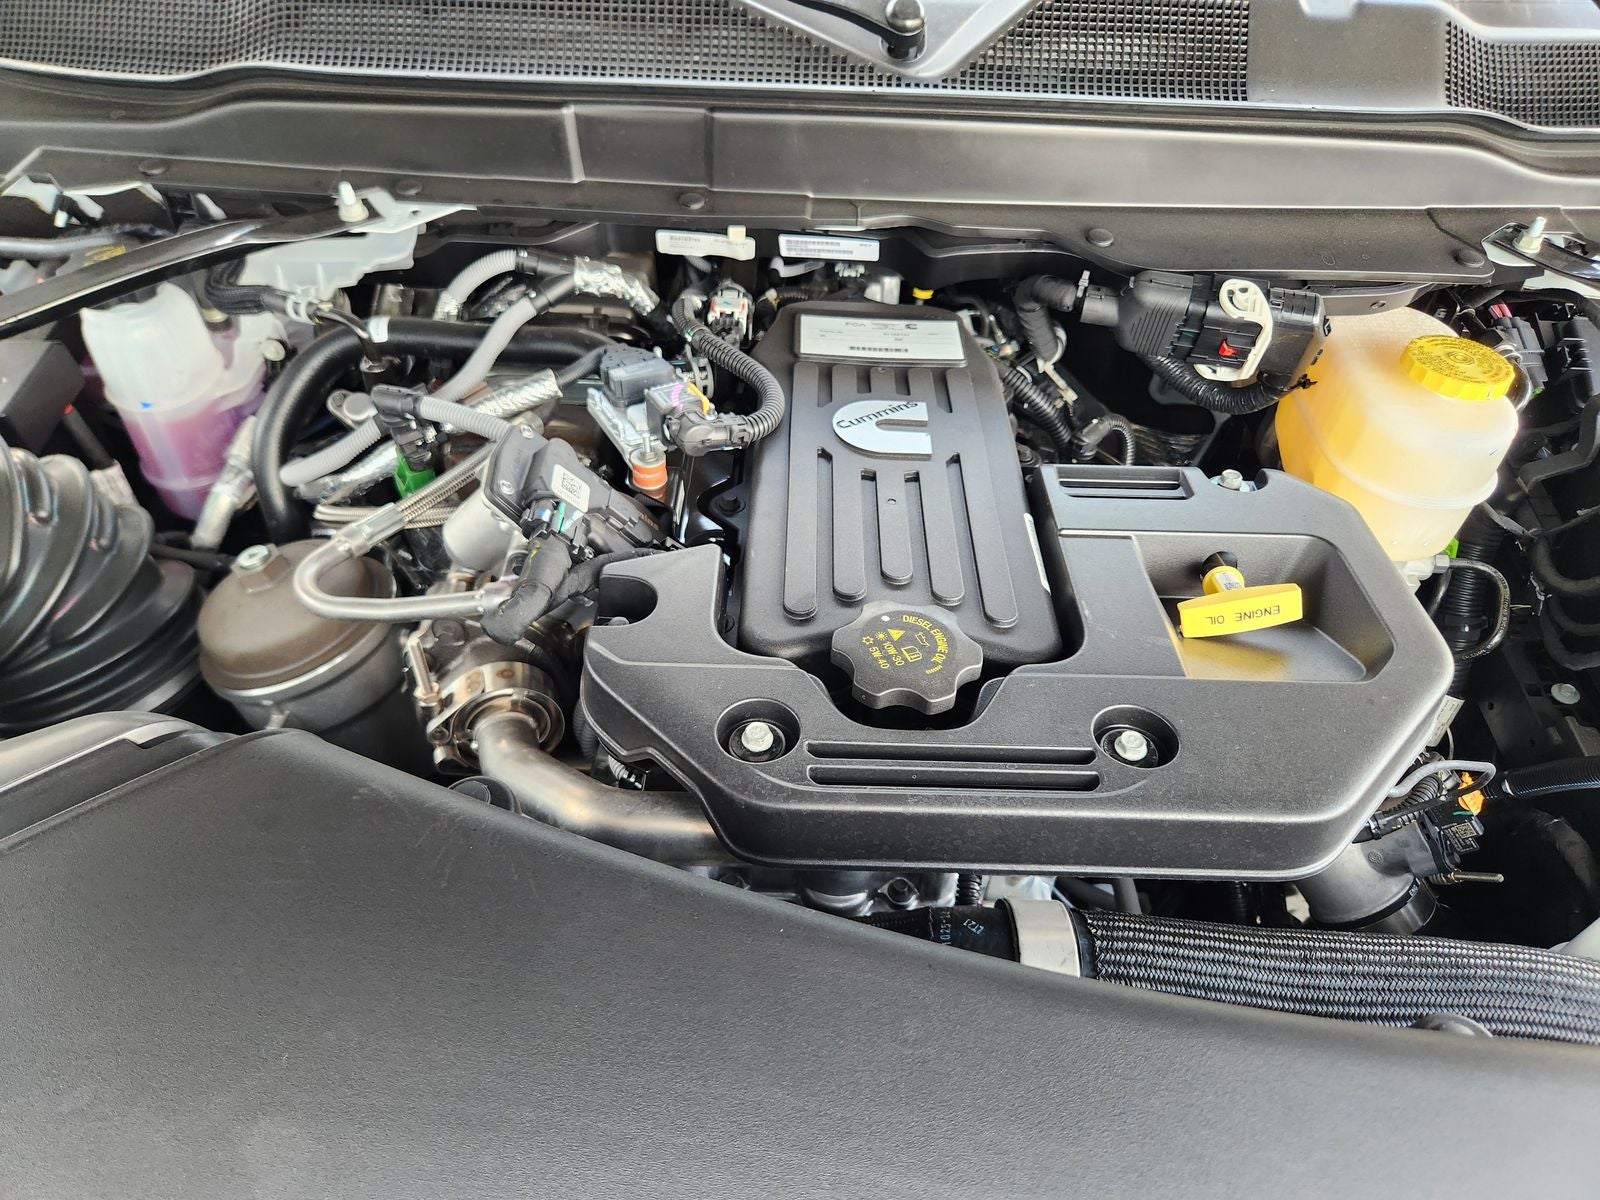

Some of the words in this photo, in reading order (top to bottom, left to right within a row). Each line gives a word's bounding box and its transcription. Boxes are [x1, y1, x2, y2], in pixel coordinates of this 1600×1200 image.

[836, 400, 919, 429] Cummins
[902, 614, 933, 630] DIESEL
[1205, 615, 1225, 625] OIL
[1235, 605, 1280, 622] ENGINE
[932, 629, 949, 654] ENGINE
[869, 646, 890, 669] 5W-40
[883, 640, 905, 666] 10W-30
[931, 654, 946, 664] OIL
